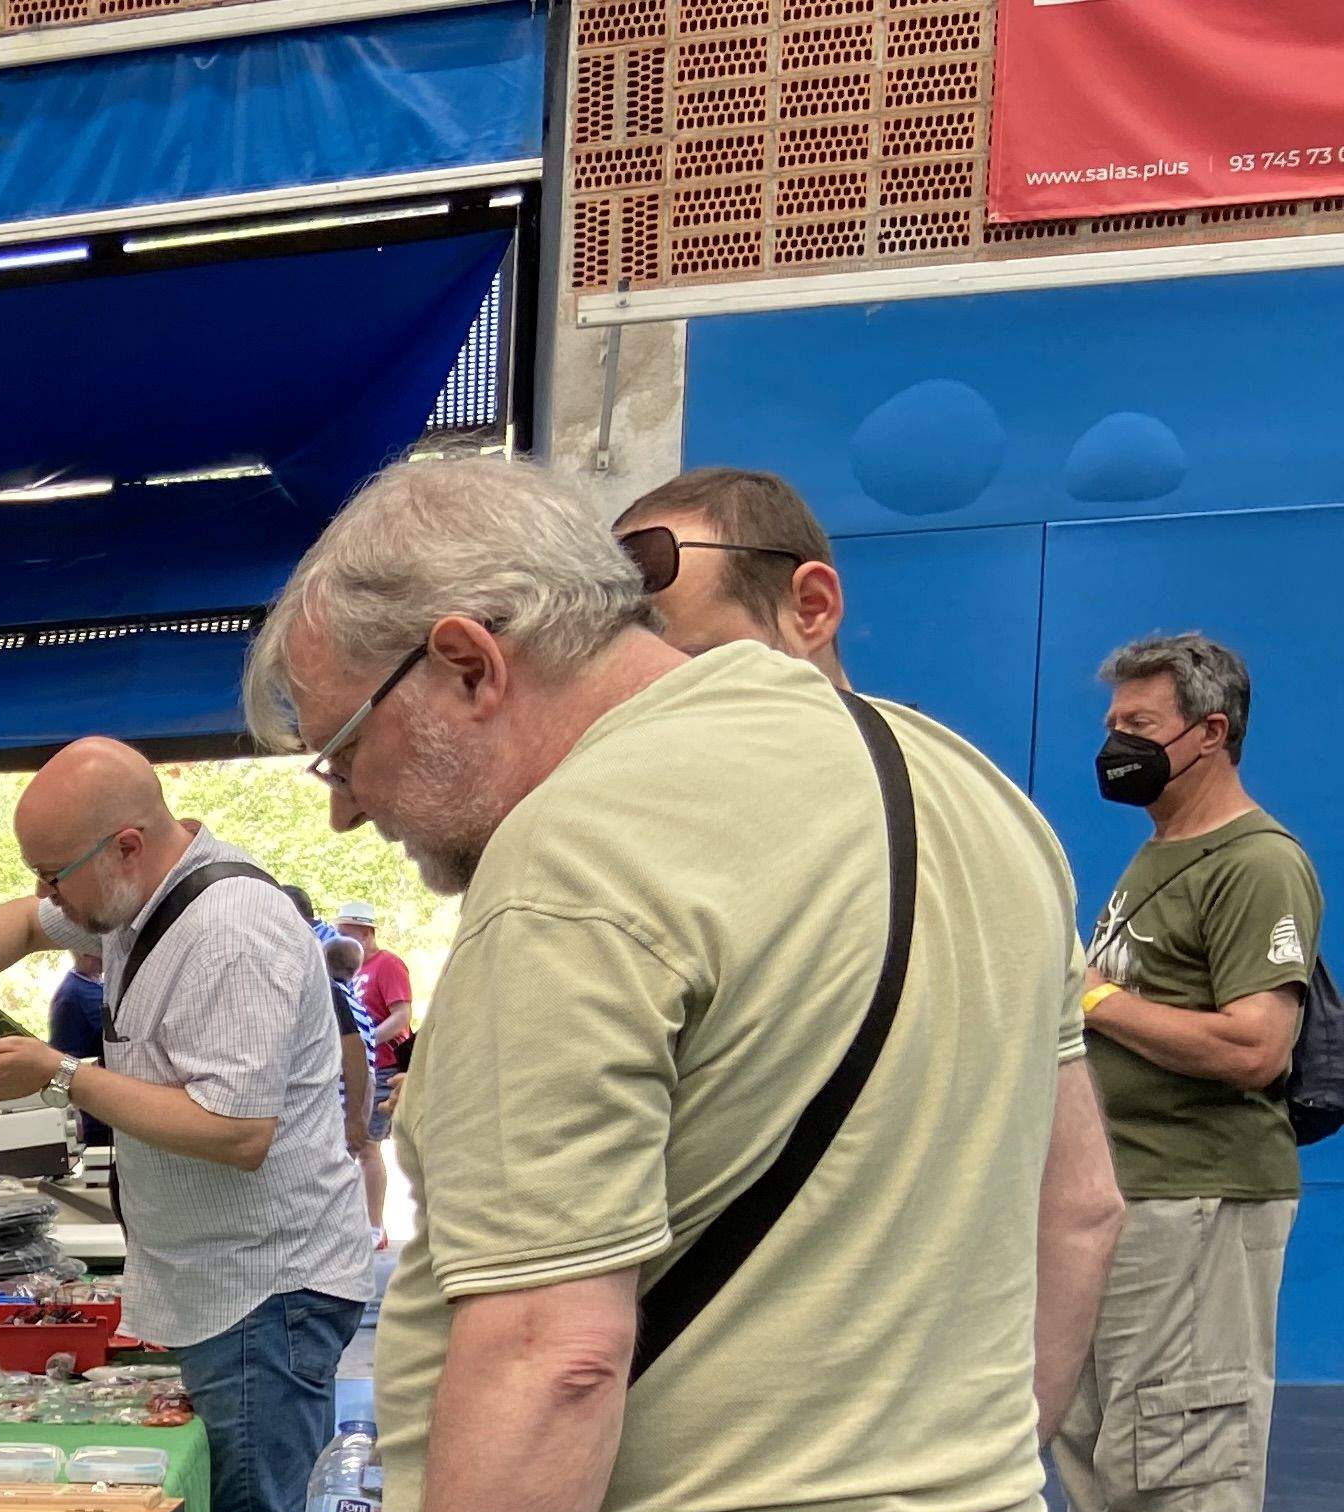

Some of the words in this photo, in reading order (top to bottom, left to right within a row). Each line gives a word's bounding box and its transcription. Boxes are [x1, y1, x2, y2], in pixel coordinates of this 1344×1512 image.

[1026, 159, 1190, 186] www.salas.plus
[1229, 153, 1255, 173] 93
[1261, 149, 1300, 169] 745
[1305, 146, 1332, 166] 73
